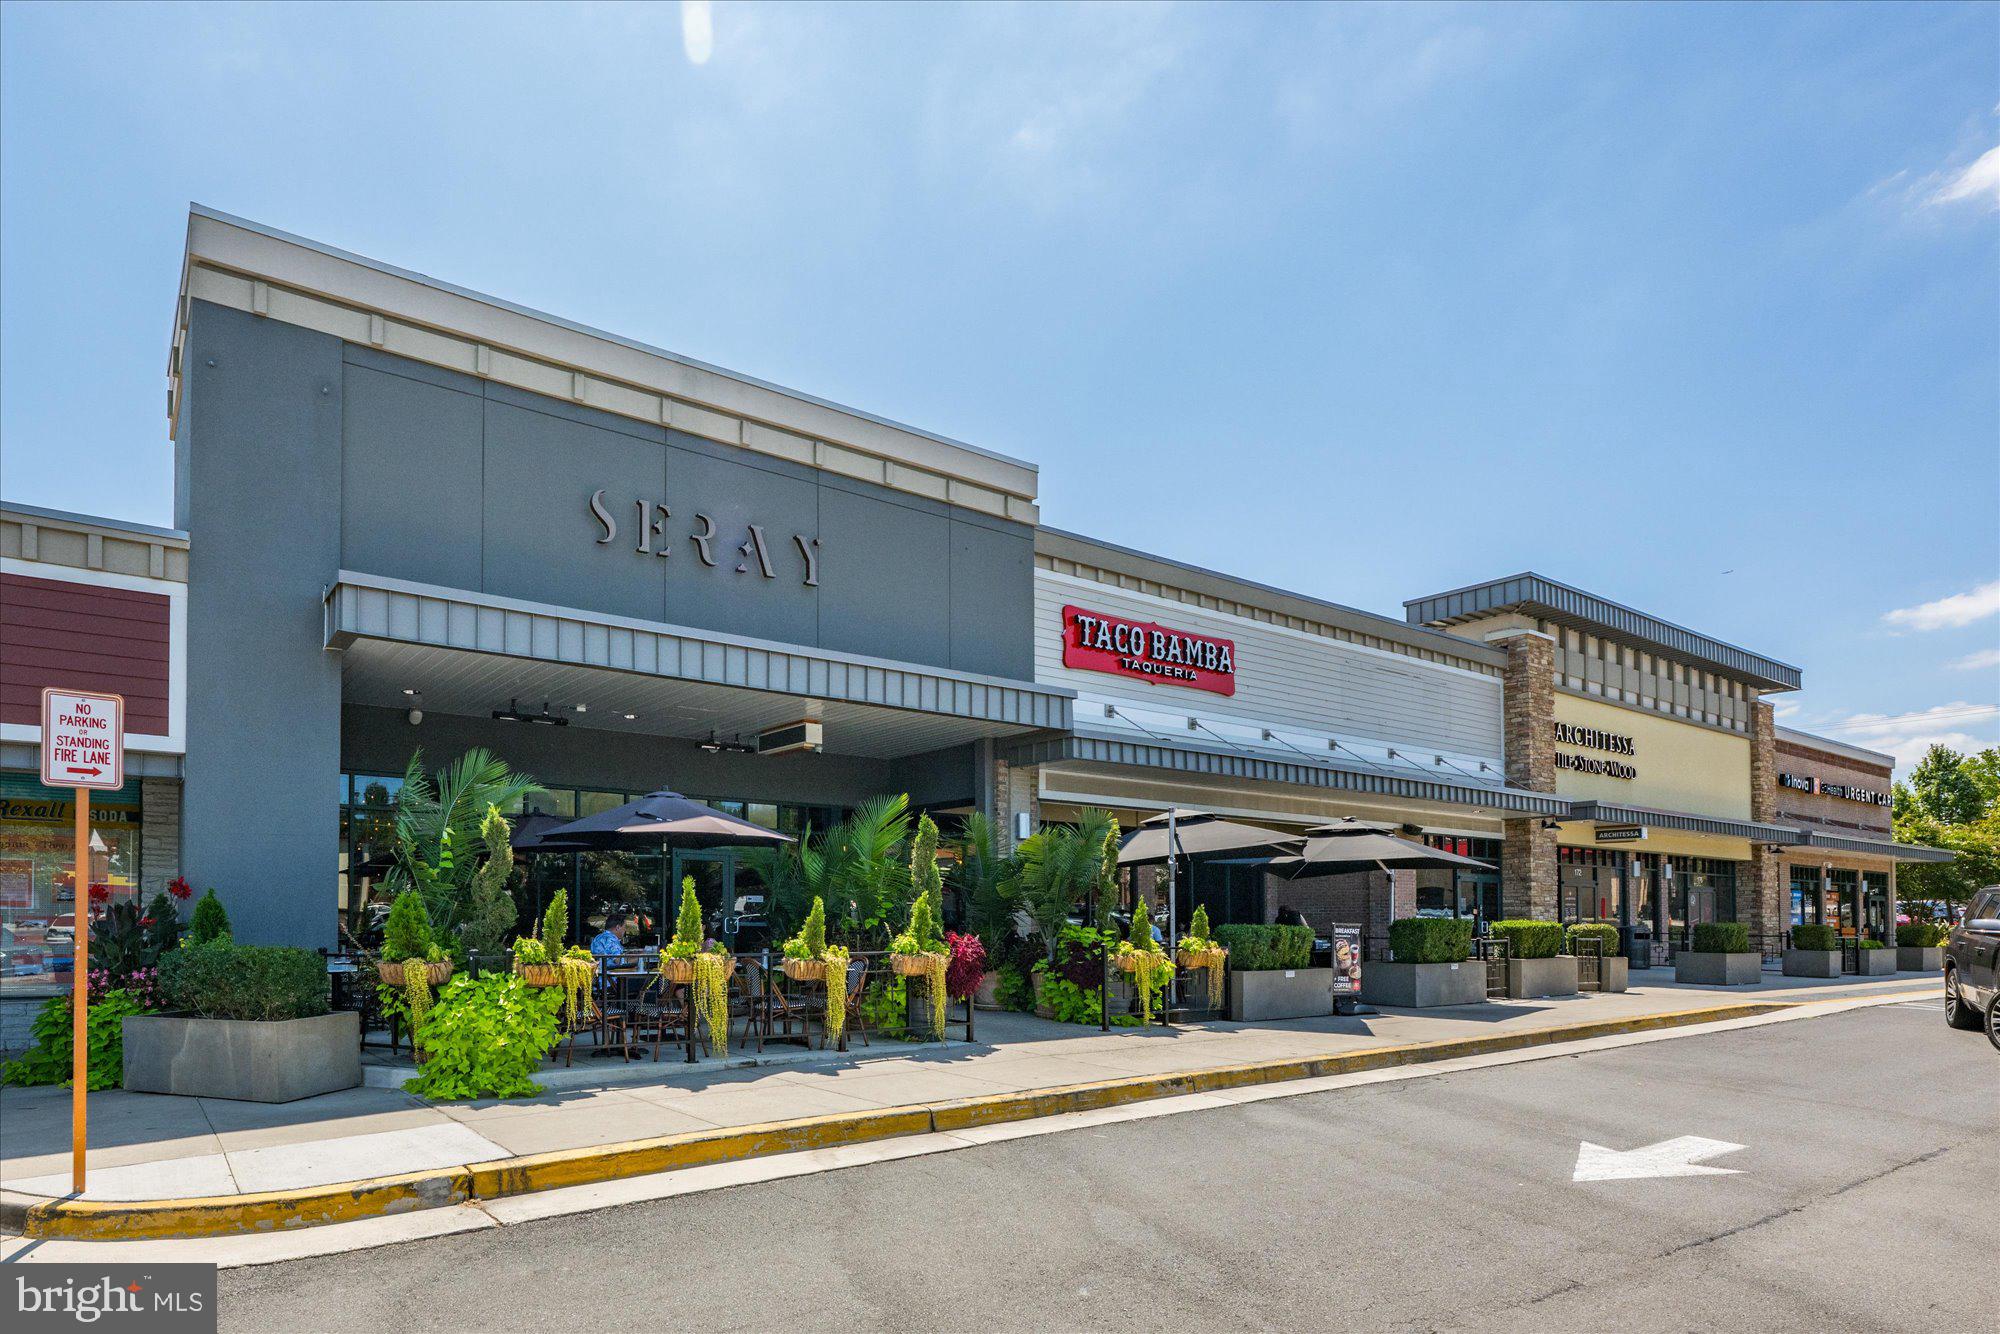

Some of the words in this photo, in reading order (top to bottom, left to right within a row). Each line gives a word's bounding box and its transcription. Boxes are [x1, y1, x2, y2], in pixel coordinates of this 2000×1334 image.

[590, 489, 823, 586] SERAY
[1077, 614, 1146, 656] TACO
[1151, 629, 1234, 674] BAMBA
[1122, 657, 1198, 681] TAQUERIA
[75, 703, 91, 715] NO
[59, 714, 107, 730] PARKING
[56, 734, 110, 750] STANDING
[1554, 721, 1637, 756] ARCHITESSA
[54, 747, 78, 763] FIRE
[83, 750, 111, 766] LANE
[1790, 774, 1809, 791] Inova
[1845, 786, 1875, 804] URGENT
[0, 800, 65, 819] Rexall
[90, 809, 128, 823] SODA
[1598, 830, 1640, 839] ARCHITESSA
[1335, 927, 1361, 935] BREAKFAST
